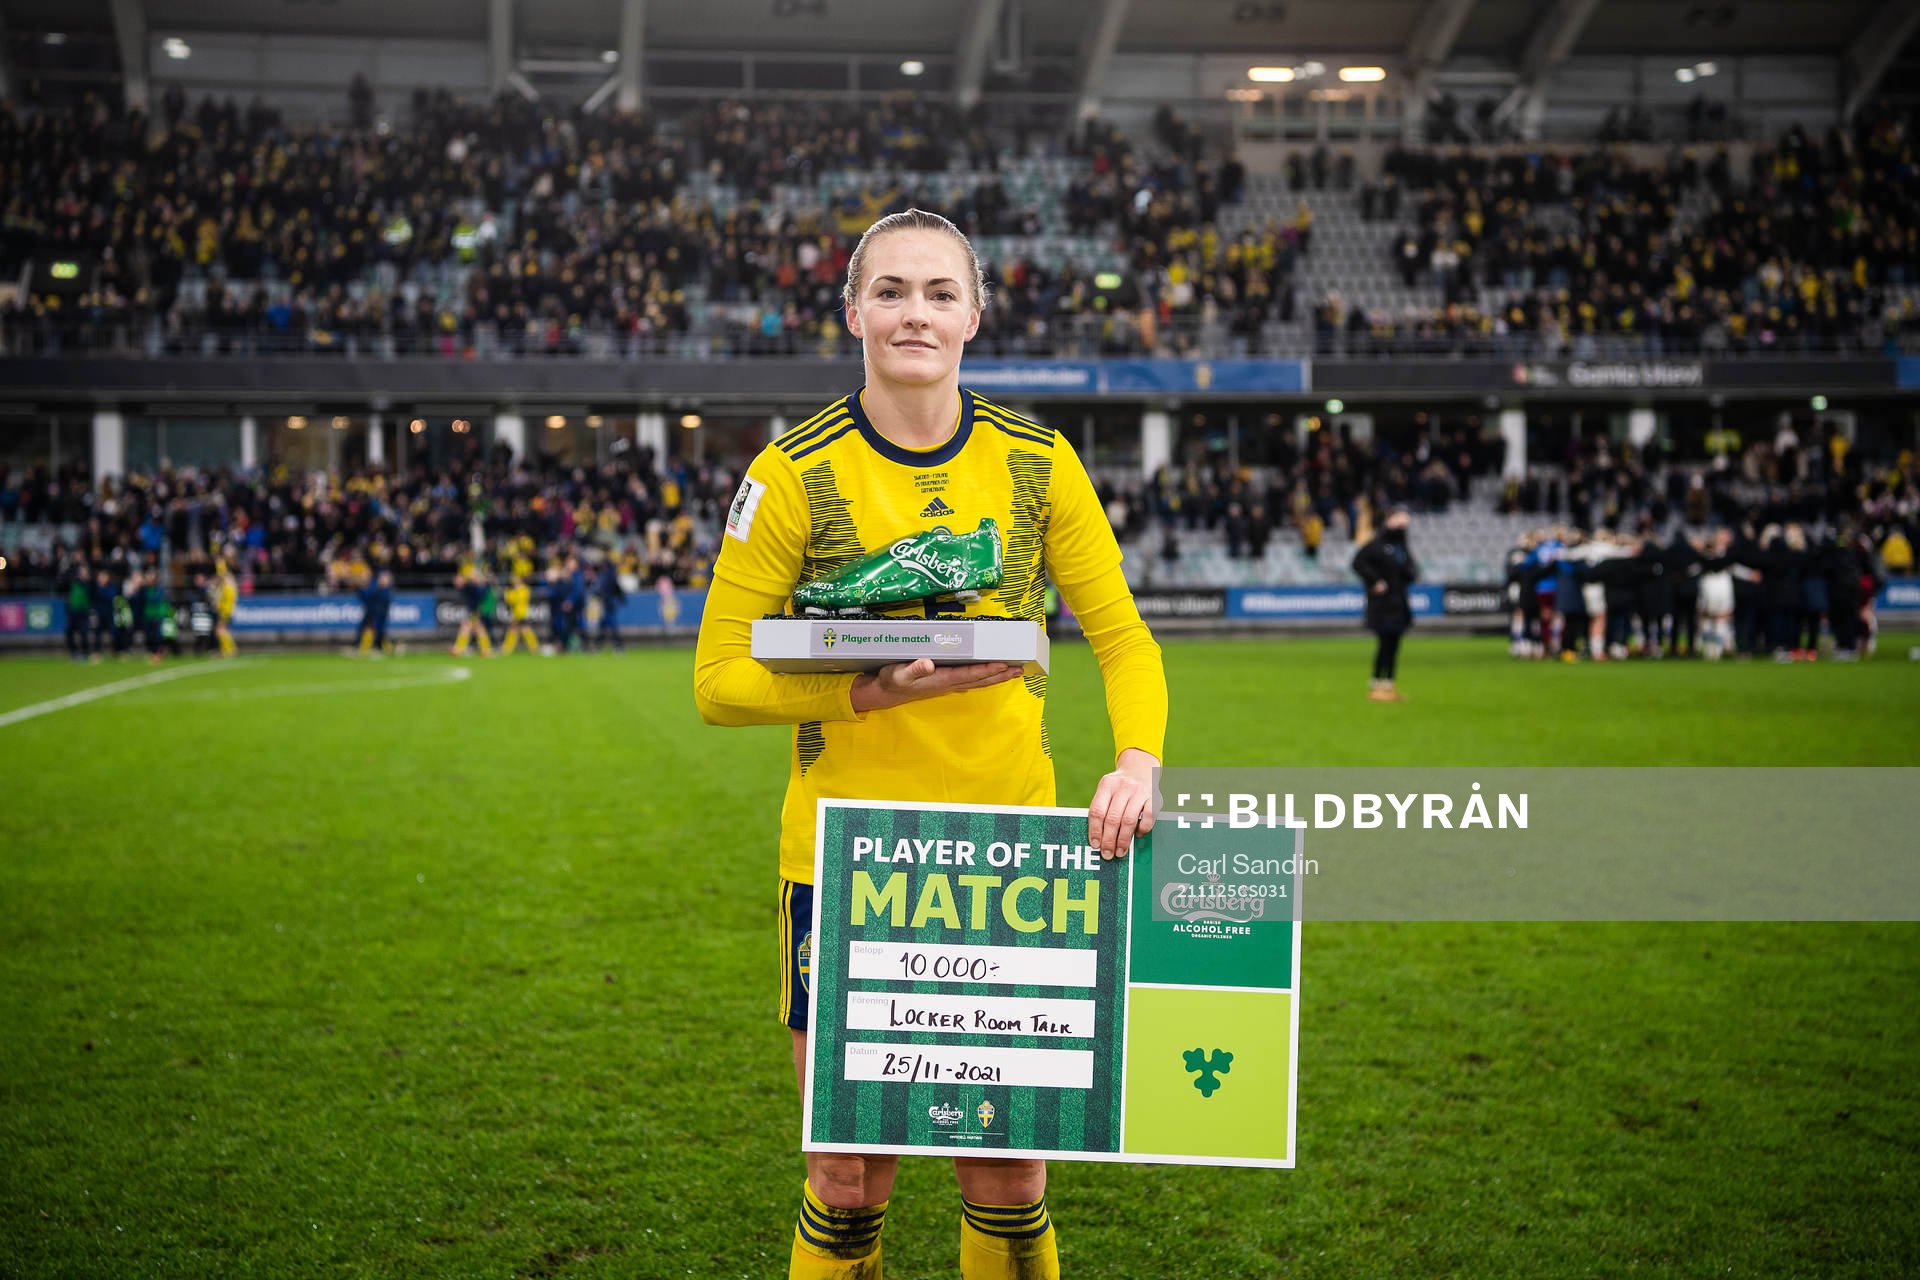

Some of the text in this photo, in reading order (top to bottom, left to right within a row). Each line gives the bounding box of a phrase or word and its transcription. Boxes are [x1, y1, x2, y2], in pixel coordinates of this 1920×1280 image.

[920, 509, 955, 518] adidas
[889, 538, 968, 588] Carlsberg
[841, 633, 931, 643] Player of the match
[934, 633, 962, 645] Carlsberg
[853, 836, 1101, 870] PLAYER OF THE
[851, 870, 1100, 934] MATCH
[1173, 924, 1251, 935] ALCOHOL FREE
[854, 945, 884, 955] Belopp
[900, 952, 927, 978] 10
[852, 995, 889, 1006] Förening
[850, 1046, 878, 1056] Datum
[928, 1105, 963, 1119] Carlsberg
